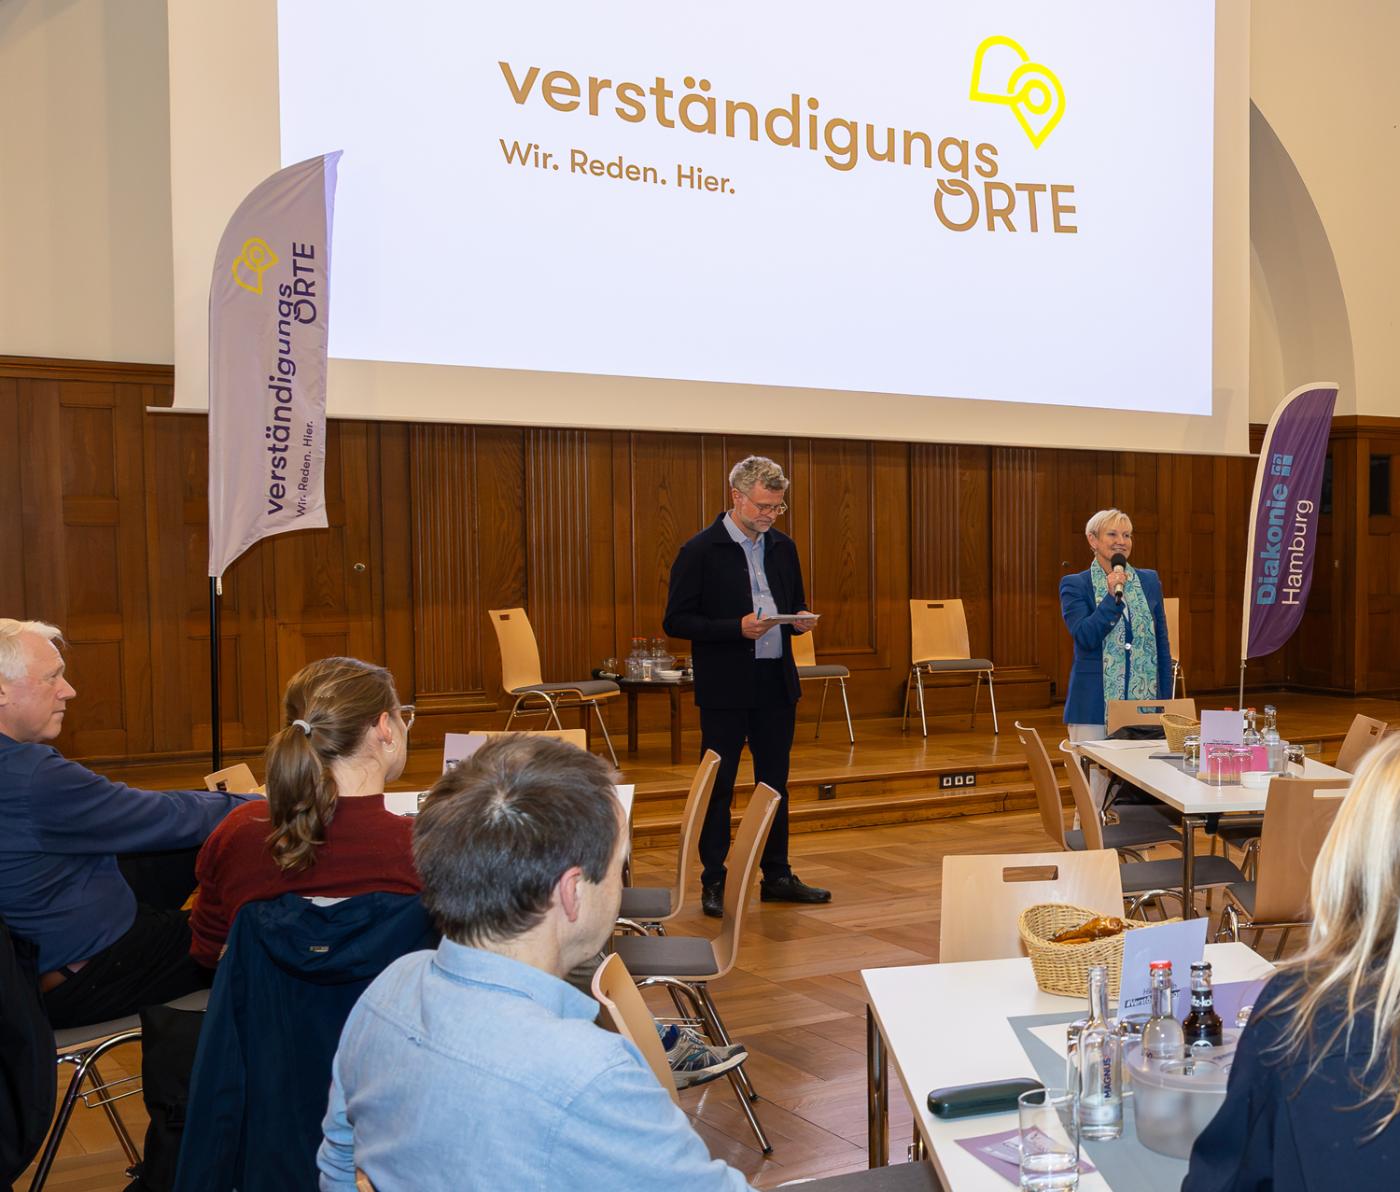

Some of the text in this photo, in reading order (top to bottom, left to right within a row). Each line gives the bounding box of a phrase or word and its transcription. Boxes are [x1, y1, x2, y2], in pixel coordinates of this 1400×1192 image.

[498, 61, 999, 180] verständigungs
[499, 138, 735, 194] Wir. Reden. Hier.
[933, 179, 1079, 234] ORTE
[292, 241, 317, 325] ORTE
[265, 283, 296, 516] verständigungs
[295, 420, 314, 518] Wir. Reden. Hier.
[1257, 484, 1288, 604] Diakonie
[1282, 500, 1313, 604] Hamburg
[1103, 1057, 1112, 1099] MAGNUS
